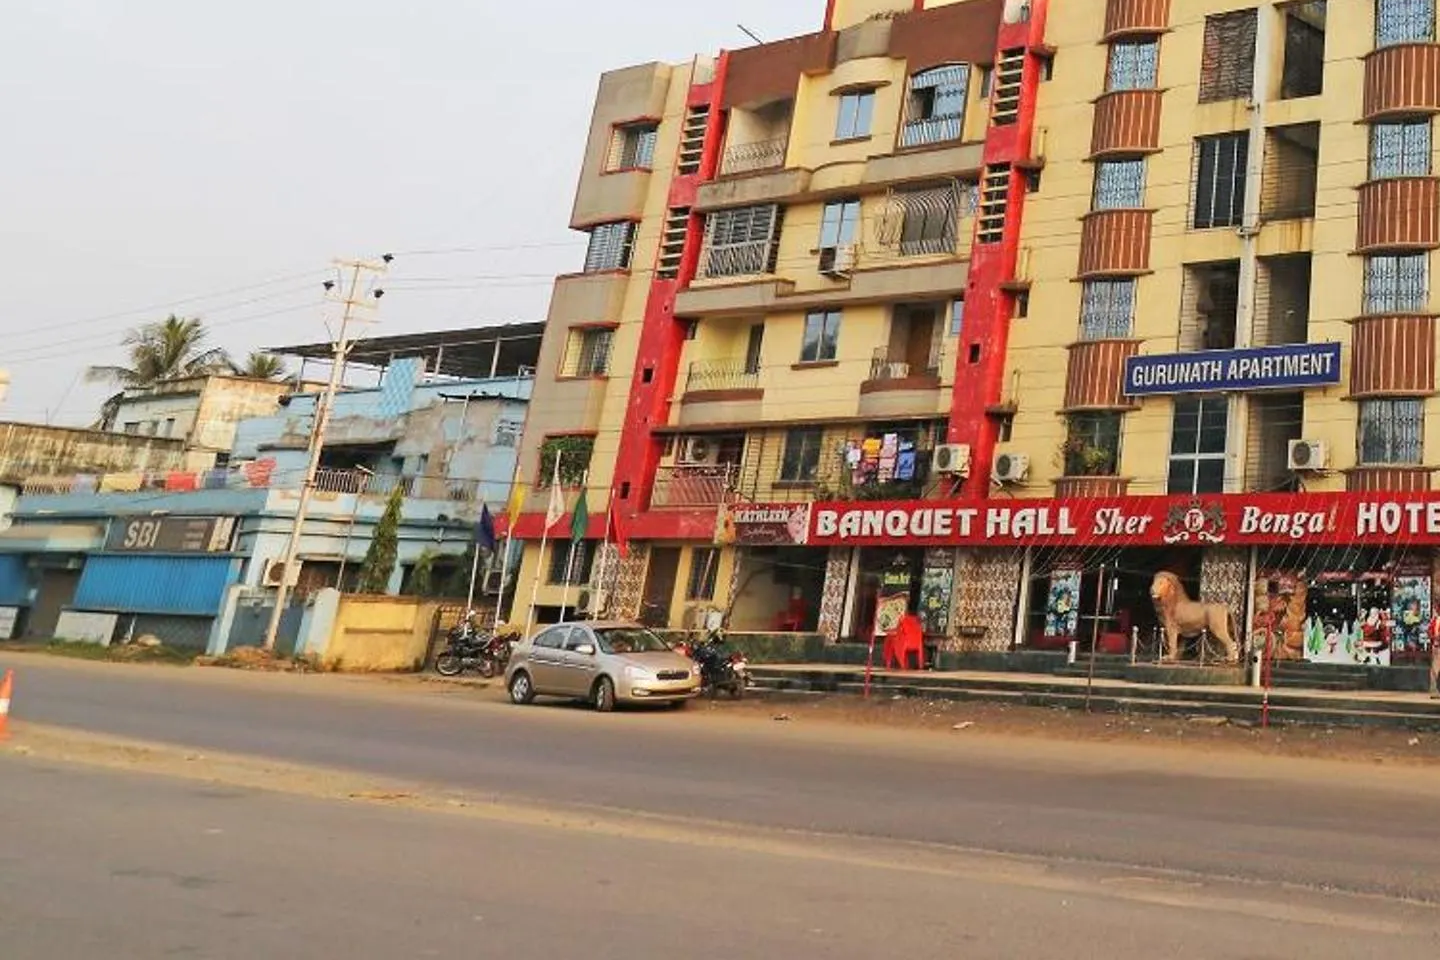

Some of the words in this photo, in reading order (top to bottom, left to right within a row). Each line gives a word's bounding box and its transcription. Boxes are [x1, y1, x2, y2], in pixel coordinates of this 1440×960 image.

[1132, 360, 1222, 387] GURUNATH
[1226, 352, 1335, 381] APARTMENT
[124, 520, 161, 548] SBI
[815, 508, 979, 539] BANQUET
[986, 506, 1077, 538] HALL
[1092, 507, 1153, 535] Sher
[1239, 499, 1338, 539] Bengal
